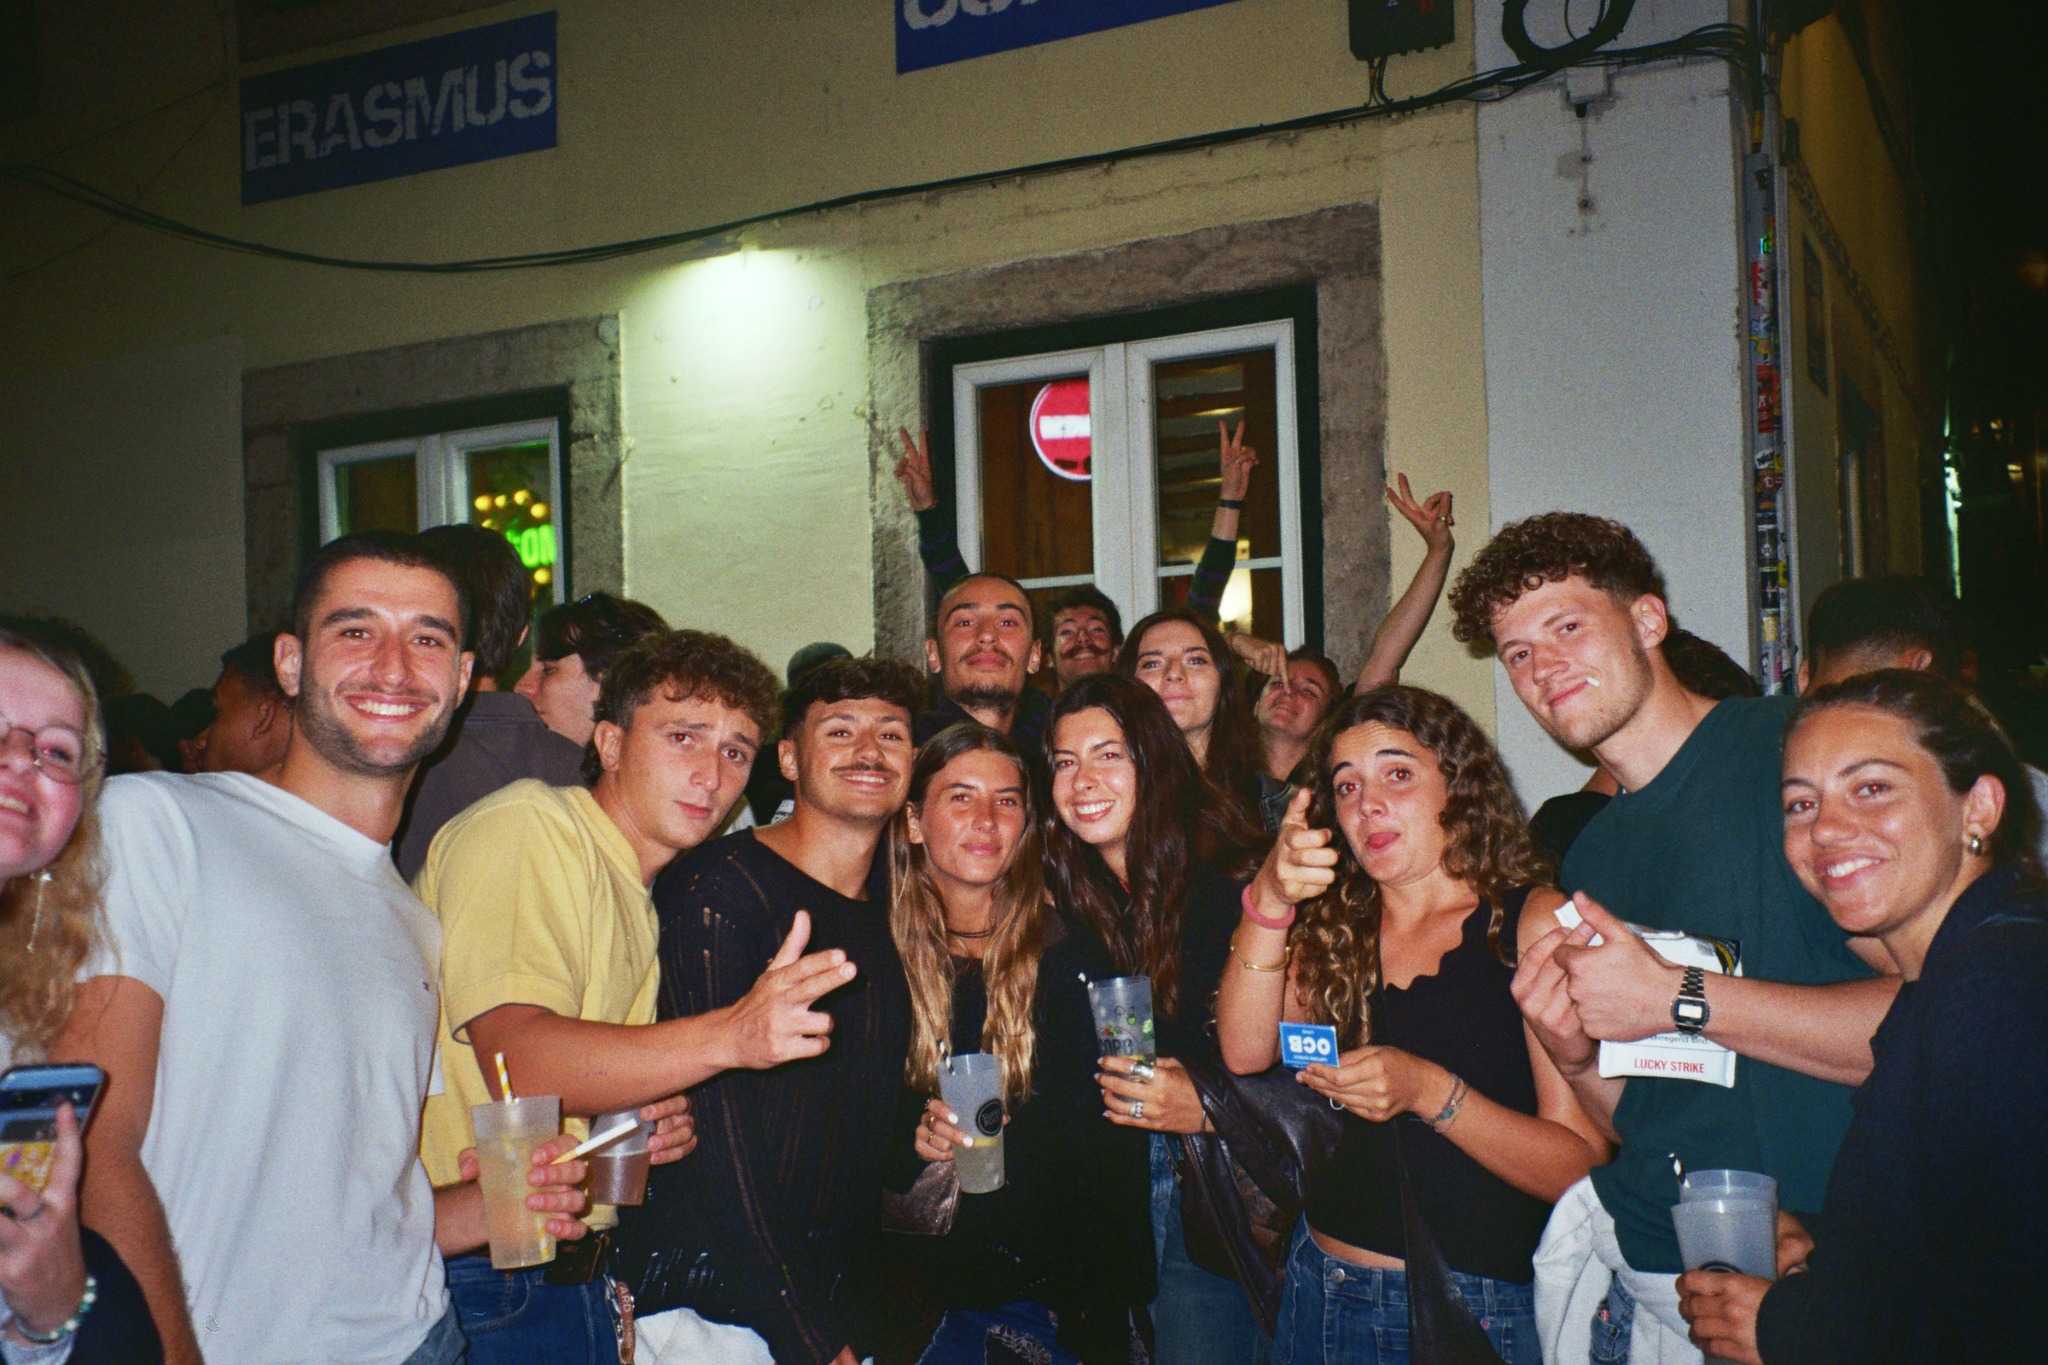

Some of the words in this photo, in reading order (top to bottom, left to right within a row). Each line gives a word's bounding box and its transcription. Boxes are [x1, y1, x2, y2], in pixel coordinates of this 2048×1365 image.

[243, 50, 553, 172] ERASMUS
[1288, 1035, 1331, 1056] OCB
[1634, 1058, 1667, 1071] LUCKY
[1670, 1061, 1705, 1074] STRIKE
